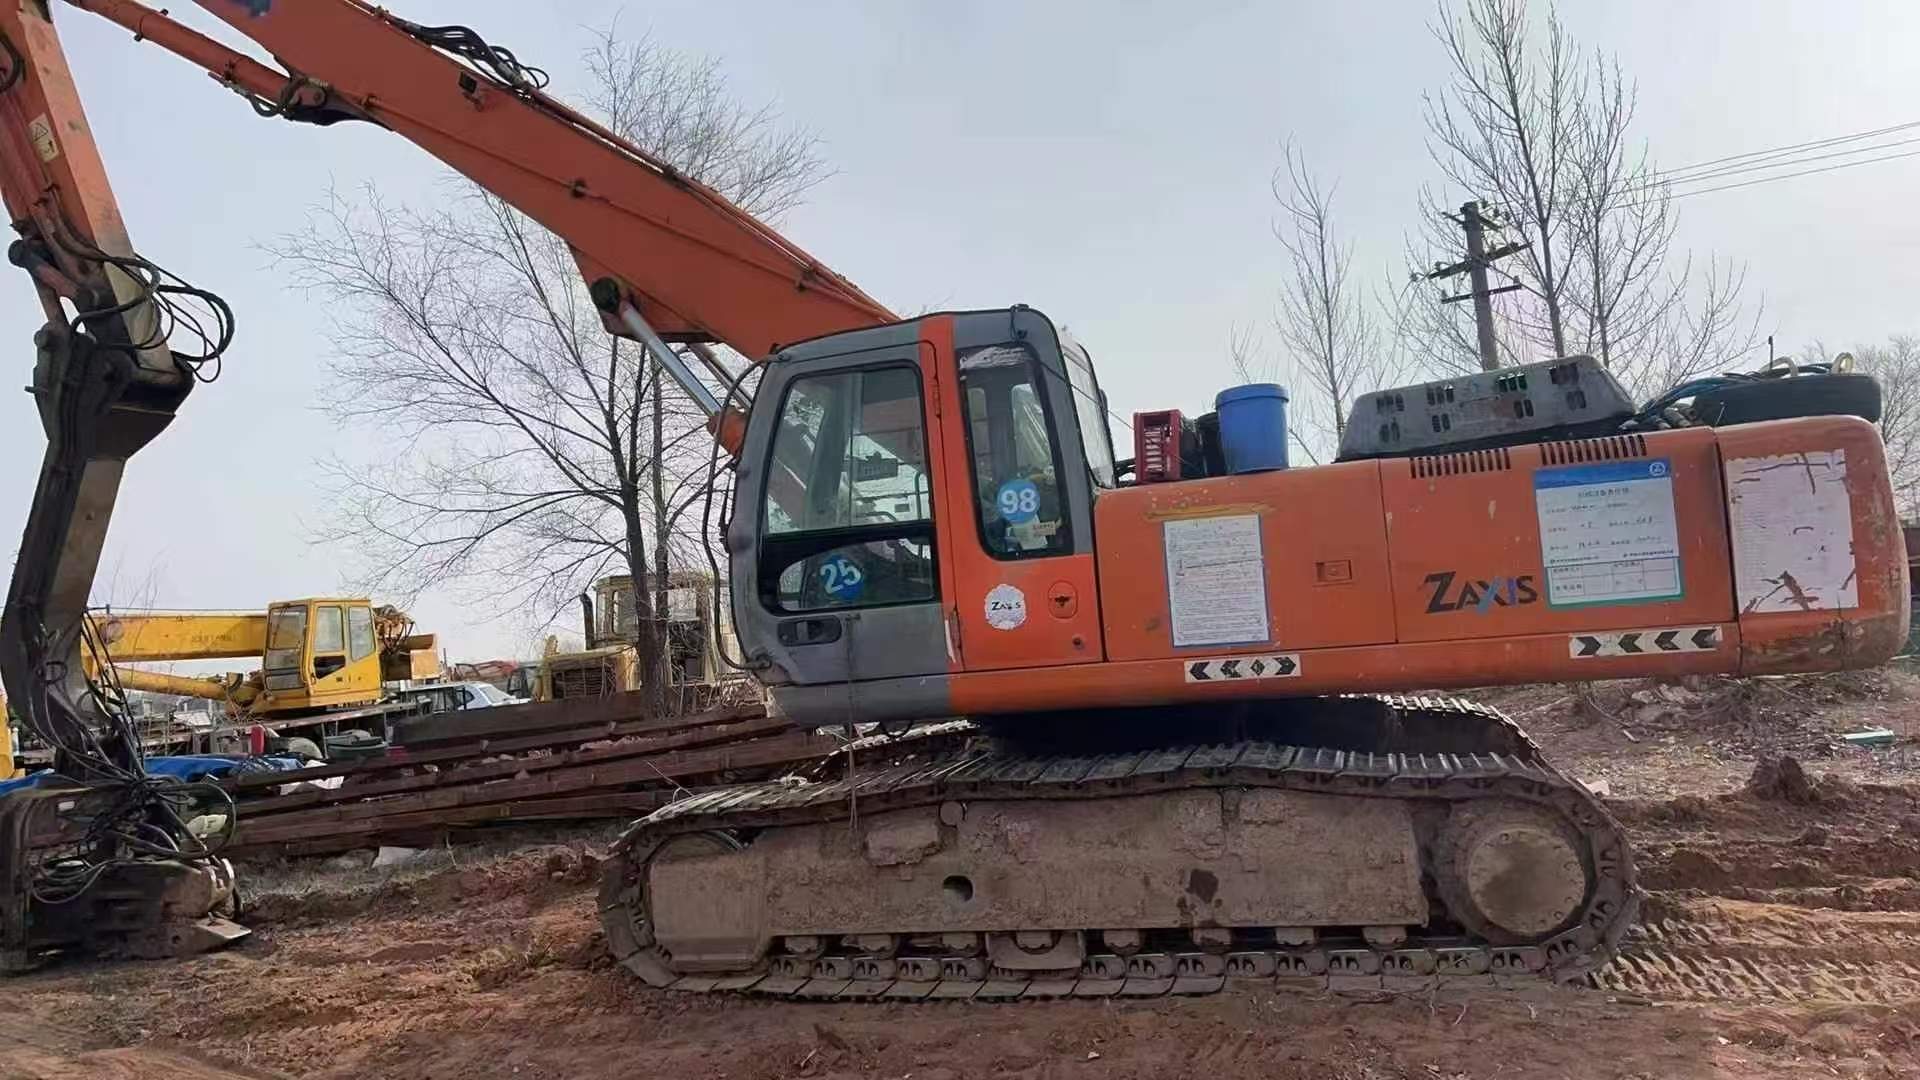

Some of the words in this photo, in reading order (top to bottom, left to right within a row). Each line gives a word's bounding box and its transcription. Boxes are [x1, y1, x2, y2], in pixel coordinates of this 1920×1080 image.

[1001, 488, 1037, 513] 98
[821, 560, 861, 594] 25
[991, 601, 1021, 610] ZAXS
[1423, 571, 1538, 615] ZAXIS
